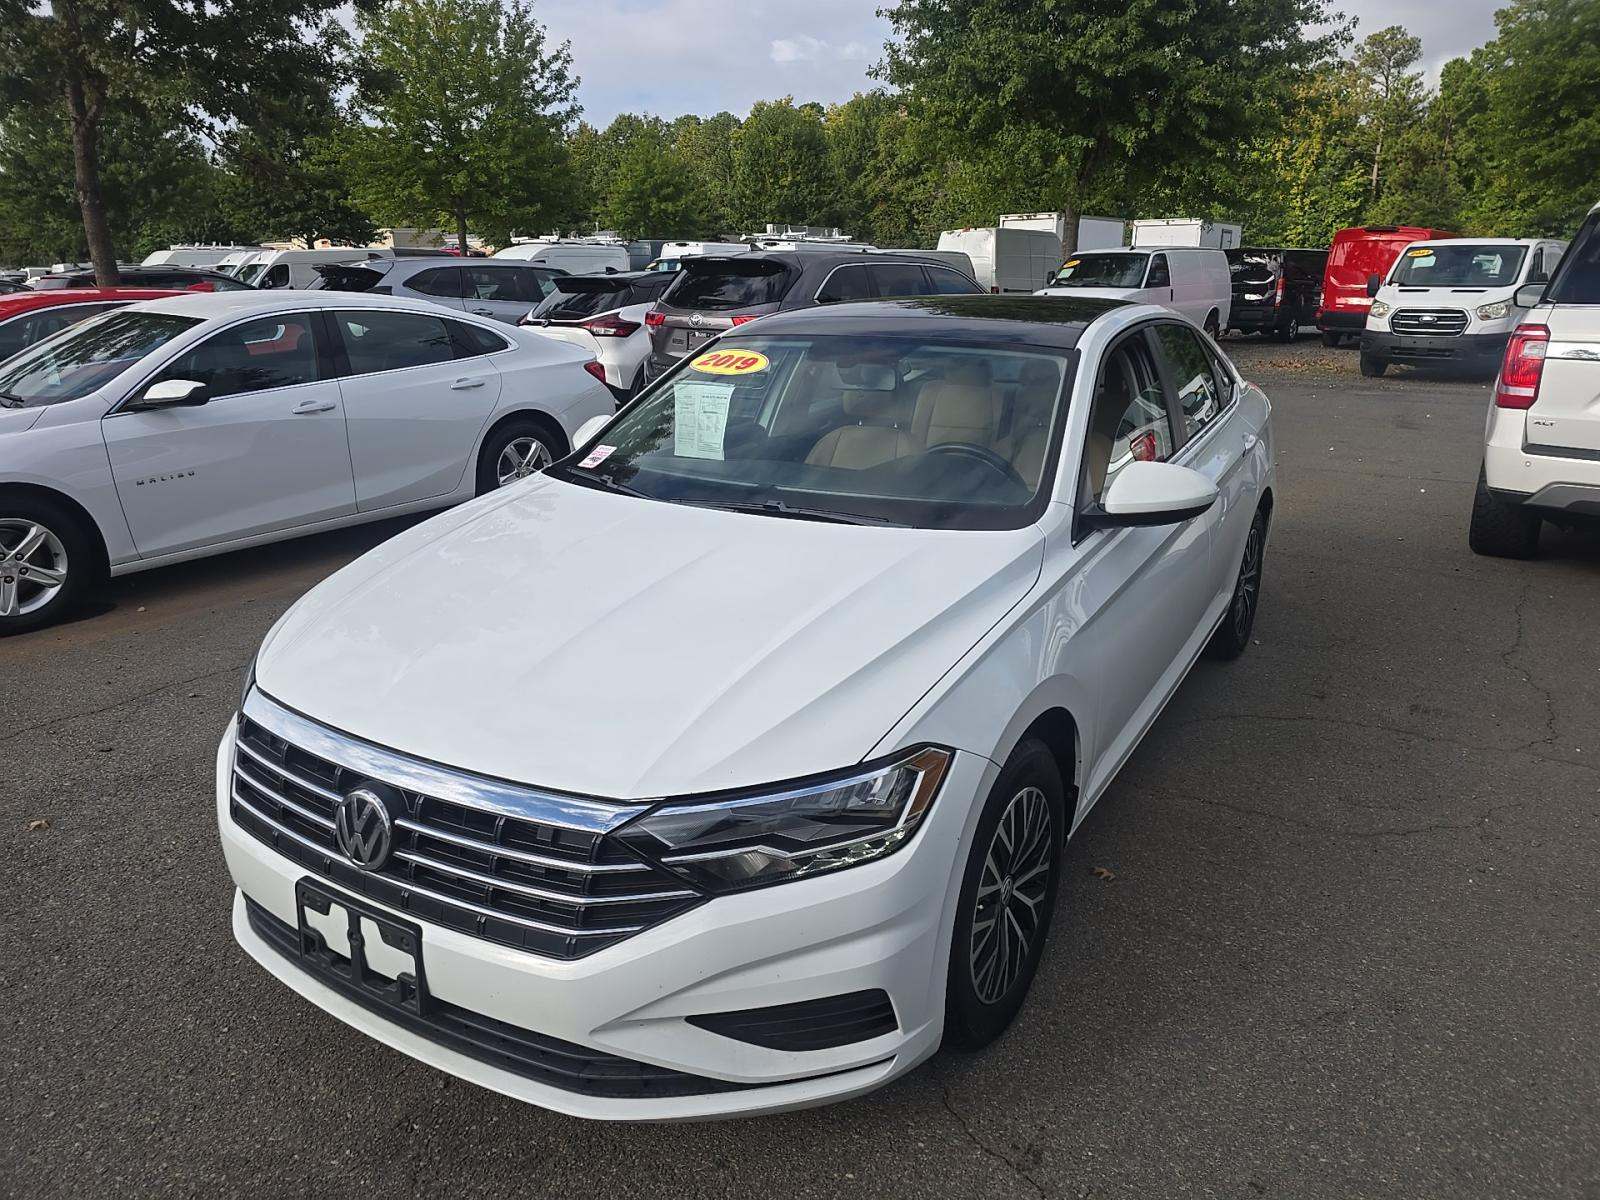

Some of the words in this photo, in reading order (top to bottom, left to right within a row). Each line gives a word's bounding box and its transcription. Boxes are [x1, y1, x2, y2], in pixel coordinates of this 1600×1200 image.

[698, 354, 759, 370] 2019
[136, 470, 195, 486] MALIBU
[338, 791, 389, 867] VW
